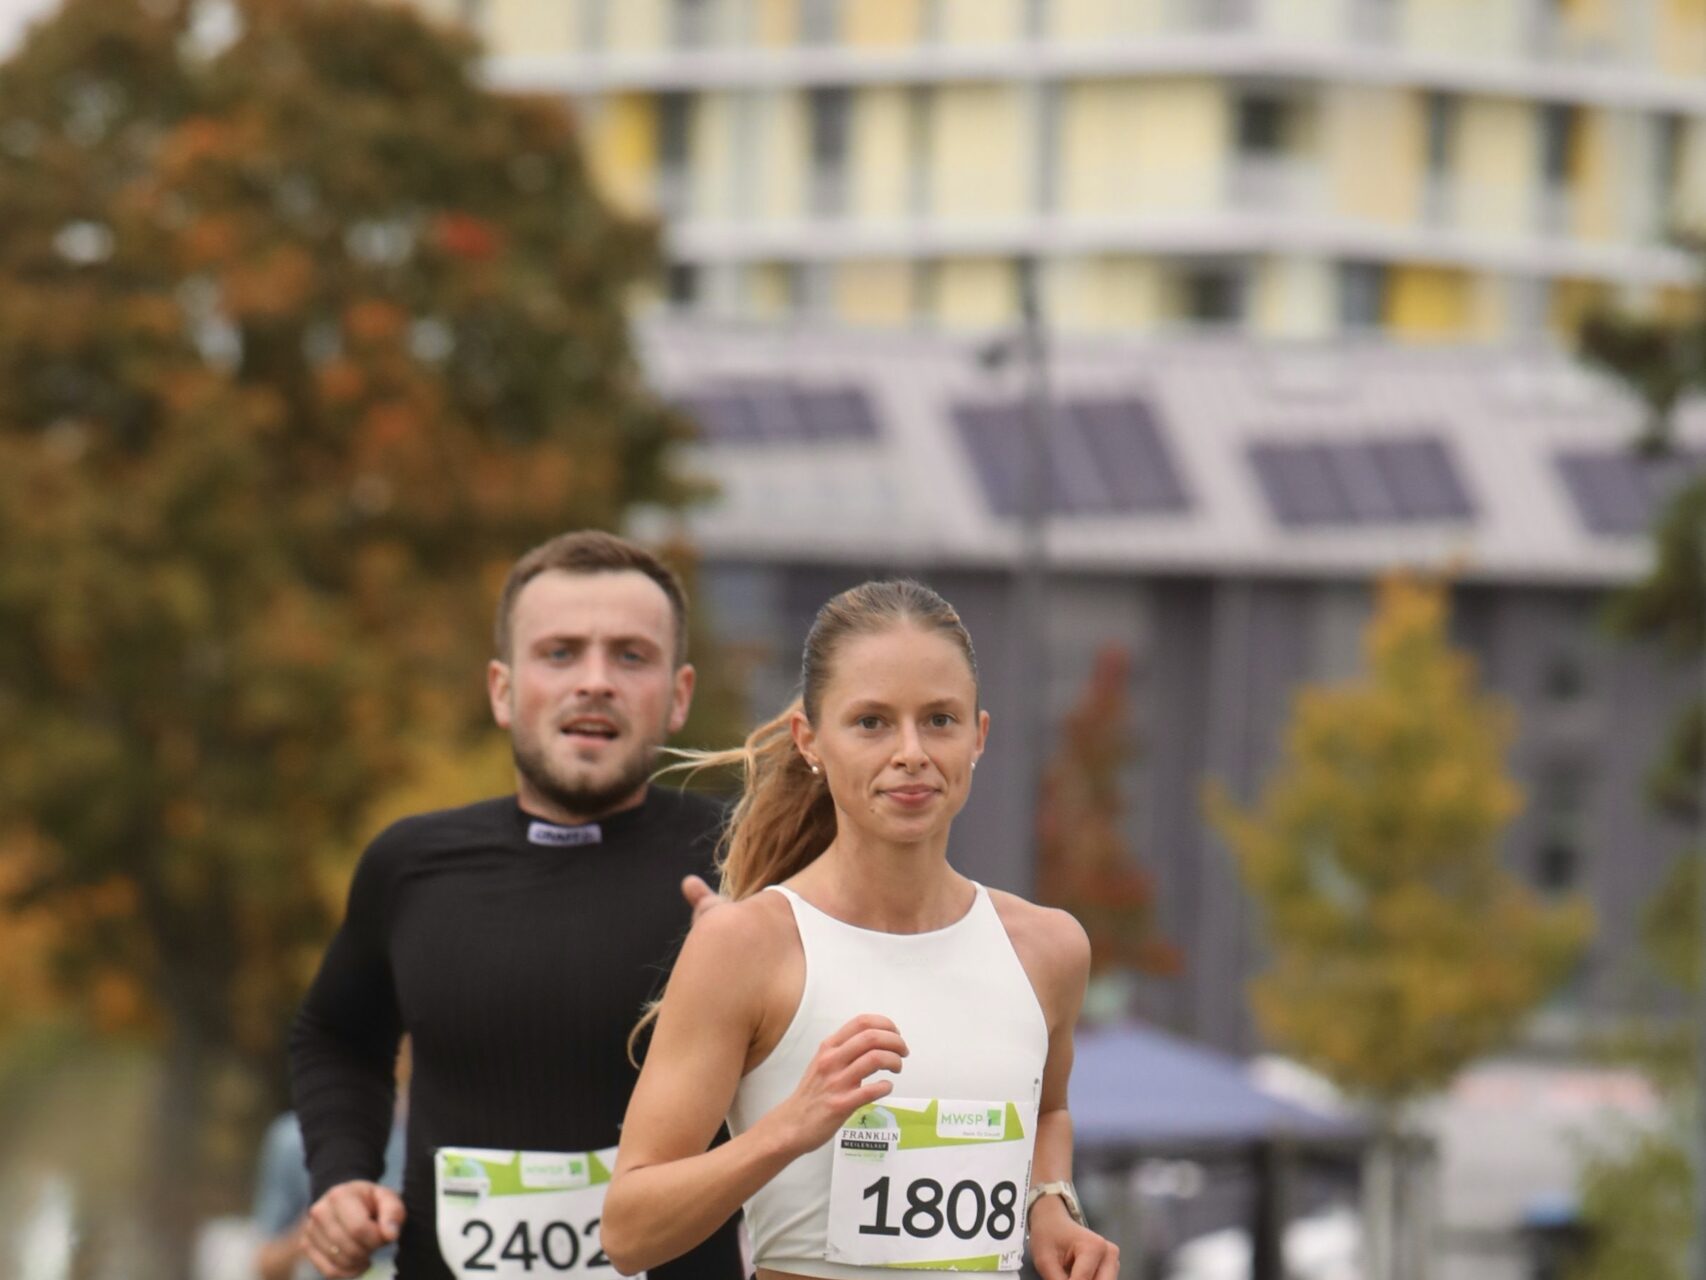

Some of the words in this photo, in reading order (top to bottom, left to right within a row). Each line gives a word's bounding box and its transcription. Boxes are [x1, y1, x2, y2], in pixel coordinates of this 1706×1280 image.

[941, 1113, 984, 1125] MWSP
[842, 1129, 899, 1141] FRANKLIN
[859, 1176, 1018, 1241] 1808
